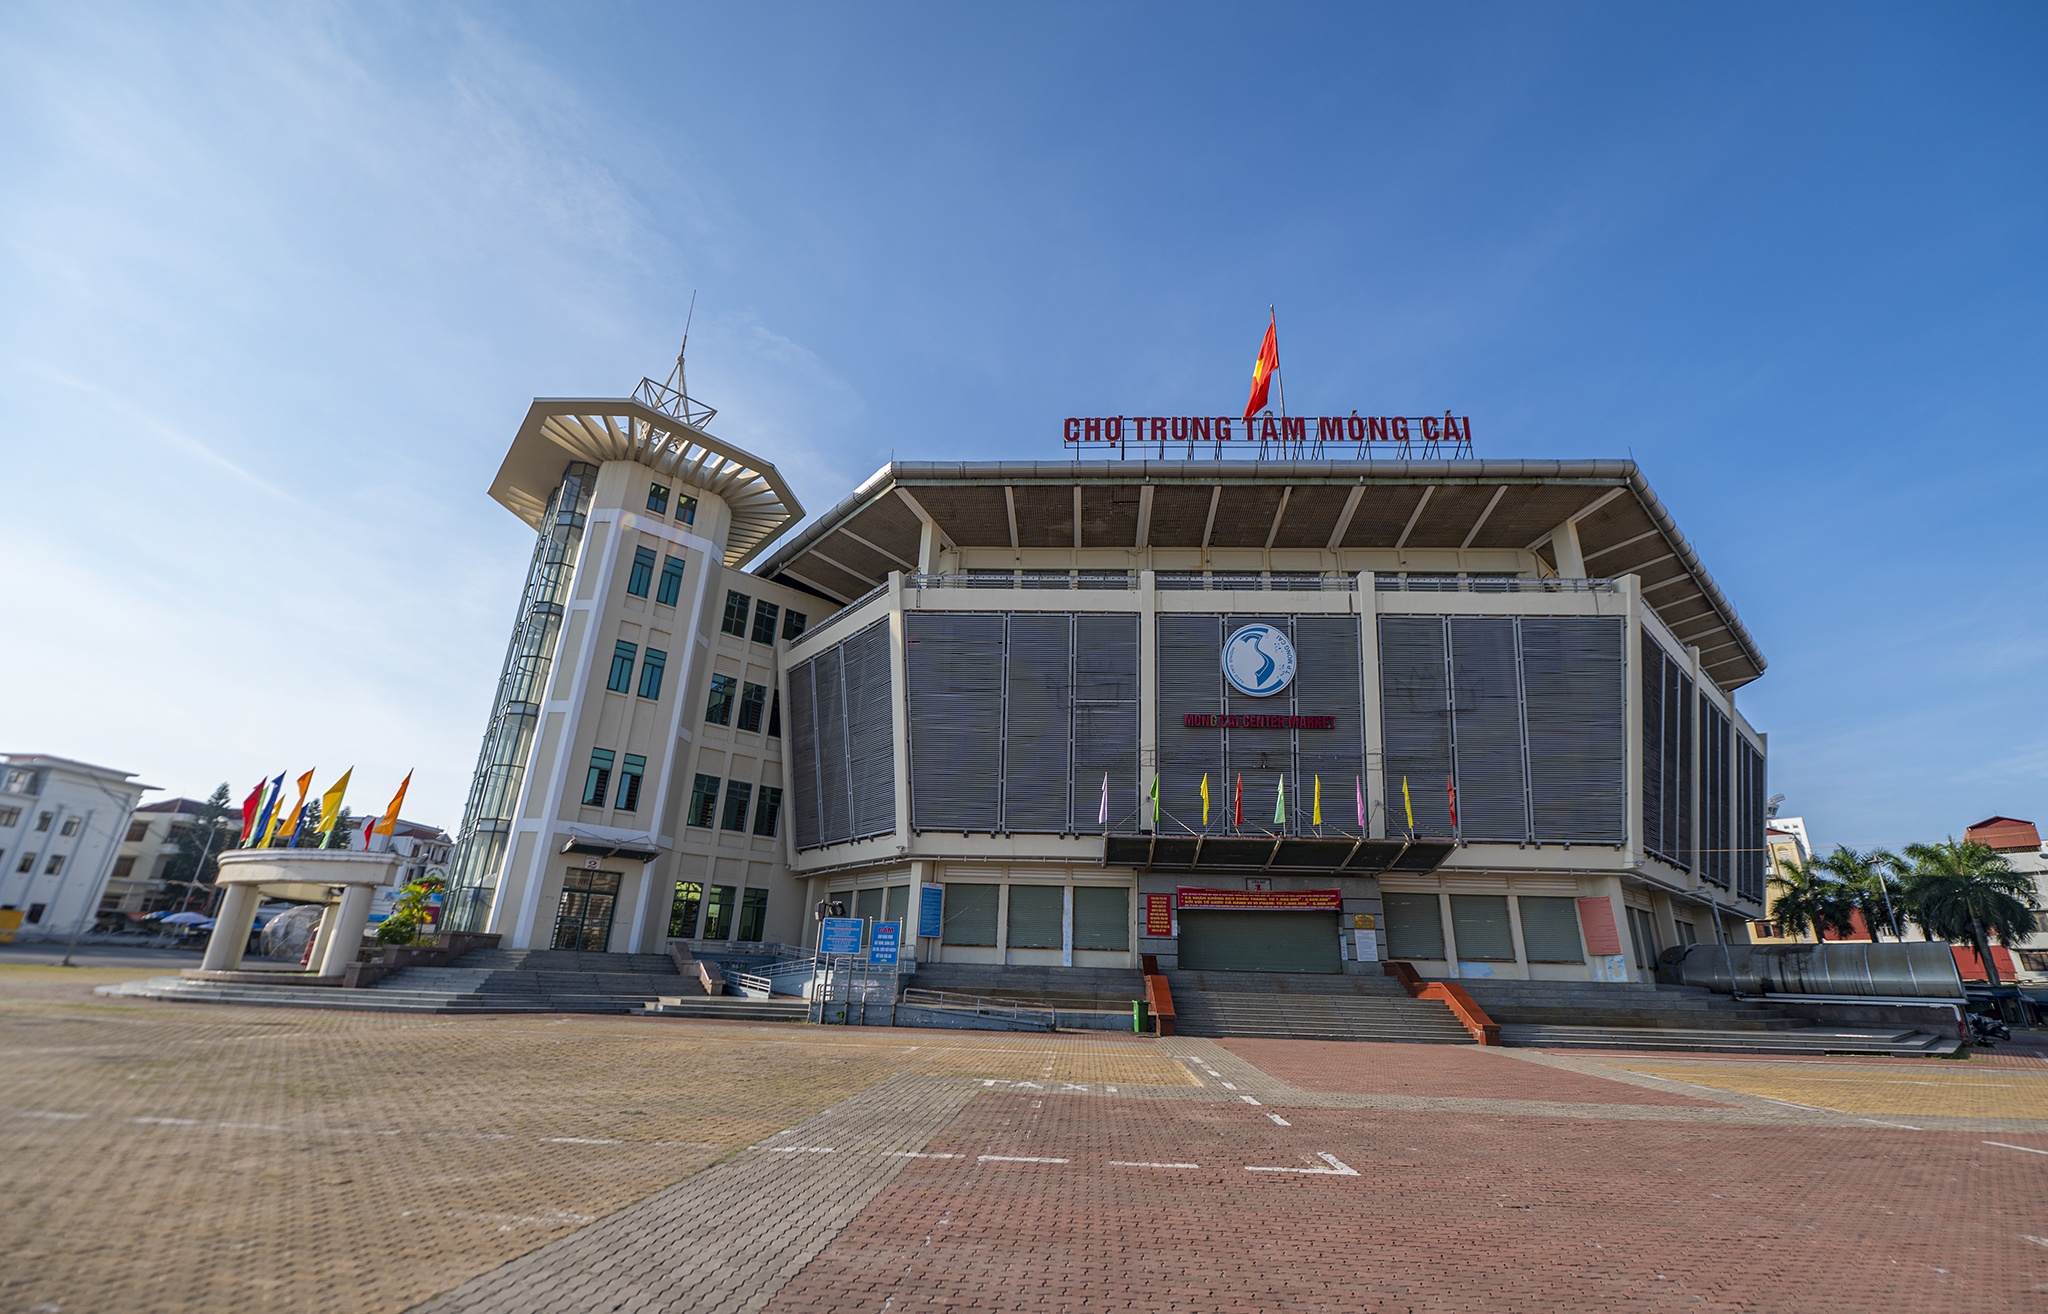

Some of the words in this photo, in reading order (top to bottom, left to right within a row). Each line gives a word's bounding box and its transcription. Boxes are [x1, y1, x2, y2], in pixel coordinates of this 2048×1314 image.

[1063, 415, 1123, 448] CHỢ
[1132, 416, 1231, 441] TRUNG
[1242, 410, 1306, 441] TÂM
[1318, 410, 1410, 441] MÓNG
[1421, 410, 1472, 441] CÁI
[1184, 714, 1217, 727] MONG
[1220, 715, 1239, 728] CAI
[1242, 715, 1285, 728] CENTER
[1288, 716, 1335, 729] MARKET
[588, 861, 597, 869] 2
